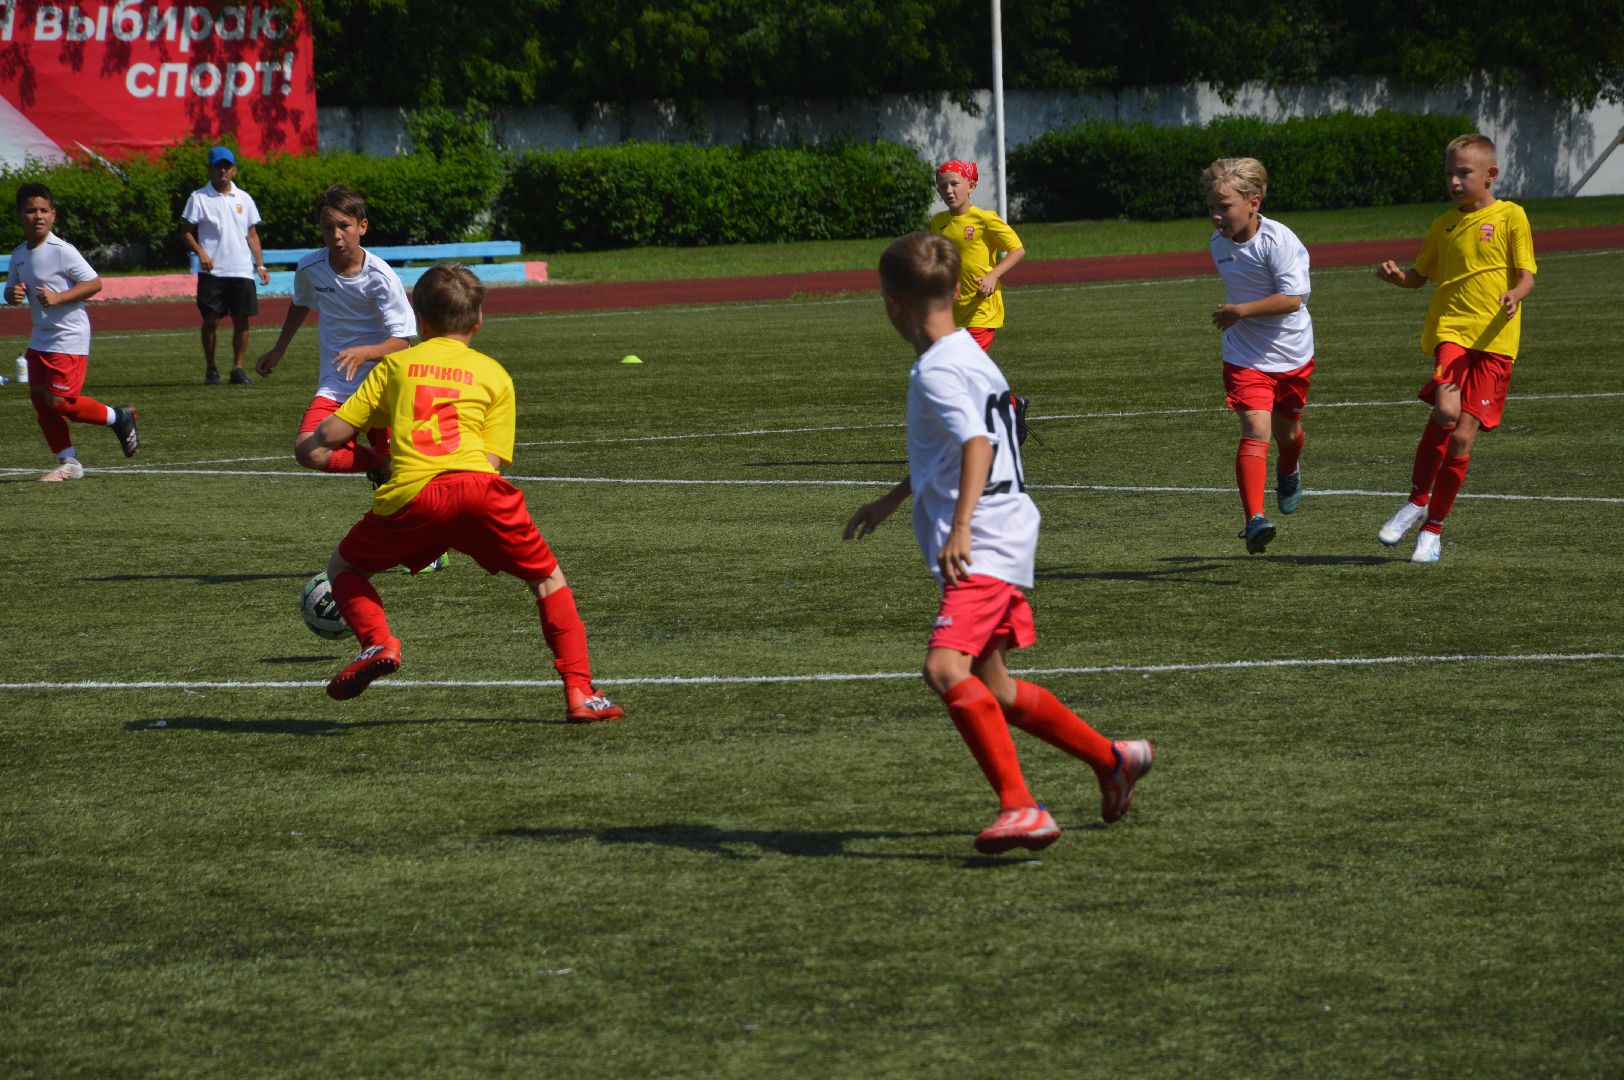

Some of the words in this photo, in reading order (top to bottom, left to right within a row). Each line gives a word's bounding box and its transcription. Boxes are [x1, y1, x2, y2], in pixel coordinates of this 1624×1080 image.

[125, 51, 294, 108] спорт!
[408, 363, 474, 385] ПУЧКОВ
[411, 384, 462, 457] 5
